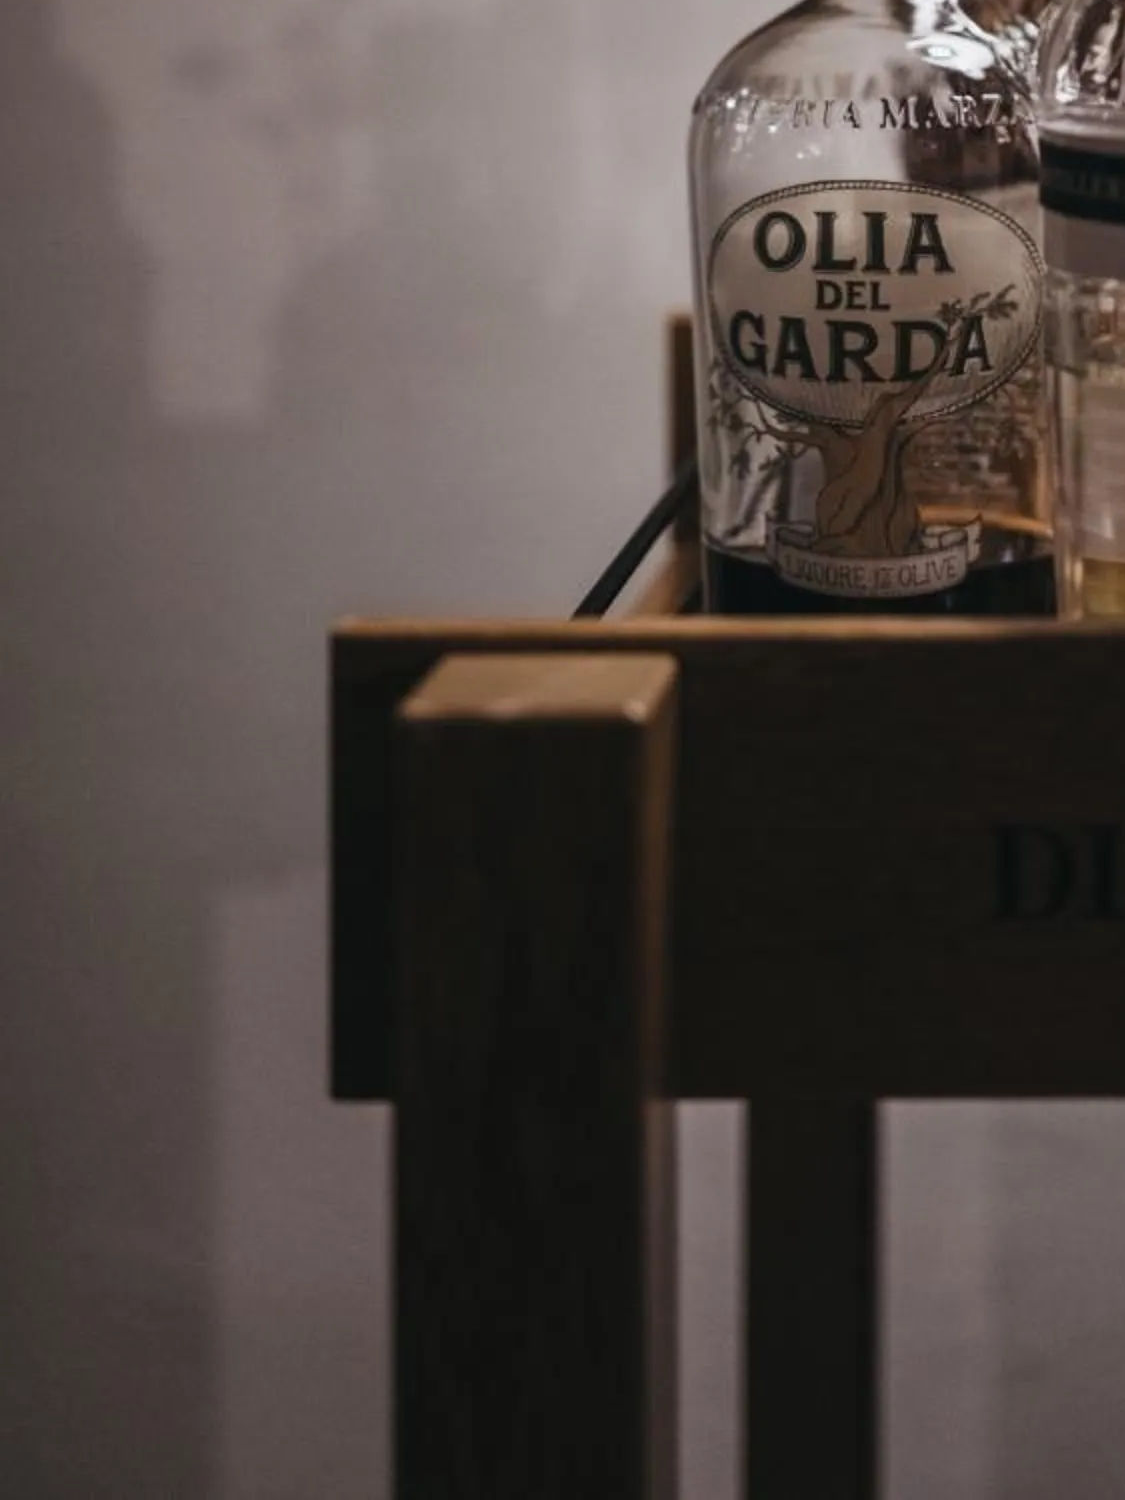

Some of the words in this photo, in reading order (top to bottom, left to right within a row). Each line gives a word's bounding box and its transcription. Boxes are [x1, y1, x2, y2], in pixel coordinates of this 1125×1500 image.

[753, 210, 954, 274] OLIA
[815, 279, 891, 312] DEL
[728, 309, 994, 385] GARDA
[897, 555, 958, 587] OLIVE
